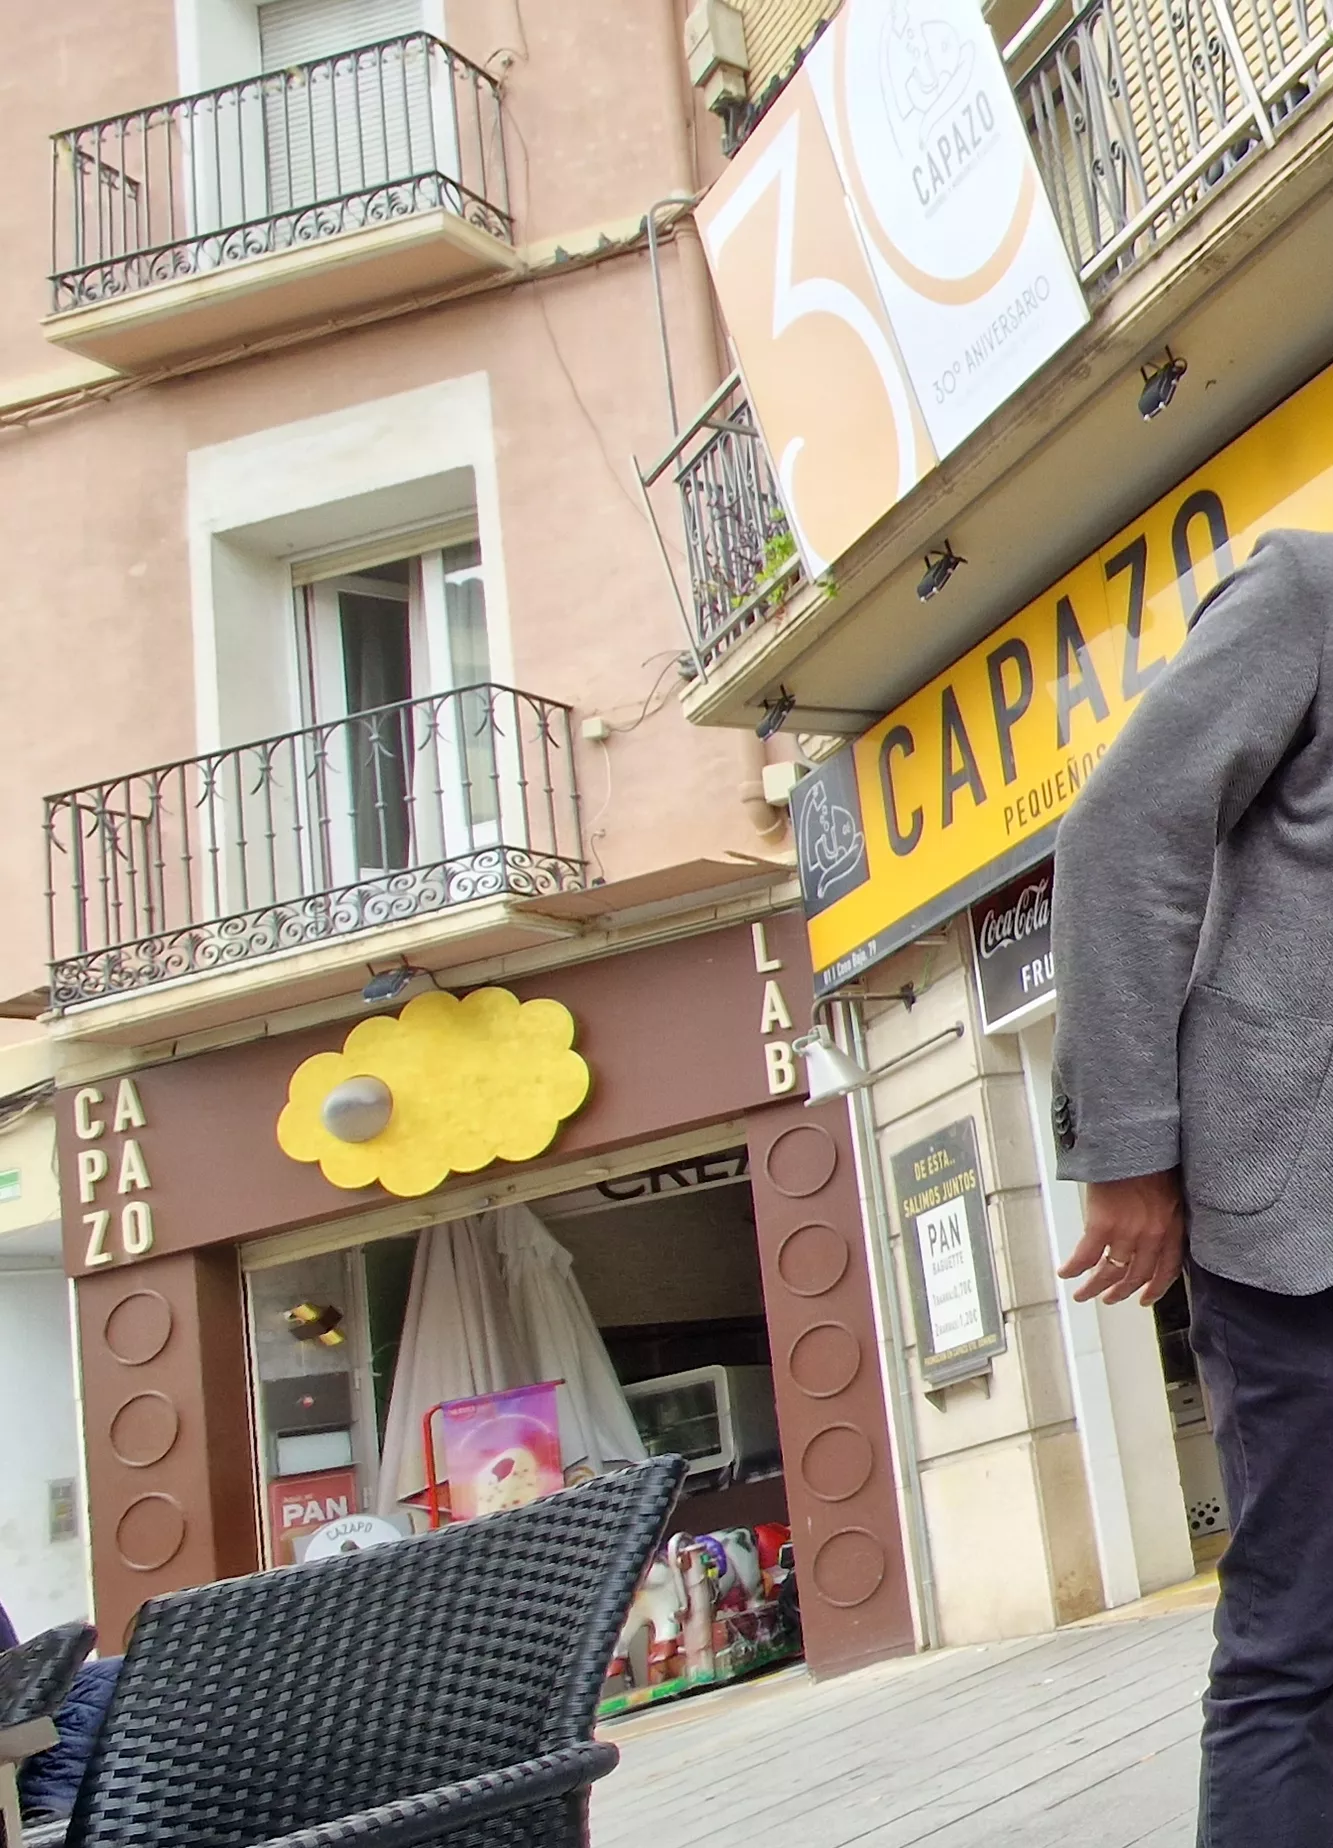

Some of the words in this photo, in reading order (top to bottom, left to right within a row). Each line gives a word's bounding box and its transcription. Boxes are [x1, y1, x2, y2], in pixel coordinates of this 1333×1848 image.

[912, 90, 995, 207] CAPAZO
[965, 275, 1050, 374] ANIVERSARIO
[878, 489, 1236, 857] CAPAZO
[1022, 952, 1055, 993] FRU
[903, 1186, 941, 1218] SALIMOS
[942, 1169, 976, 1201] JUNTOS
[914, 1160, 927, 1181] DE
[928, 1212, 961, 1258] PAN
[932, 1251, 964, 1275] BAGUETTE
[282, 1495, 348, 1528] PAN
